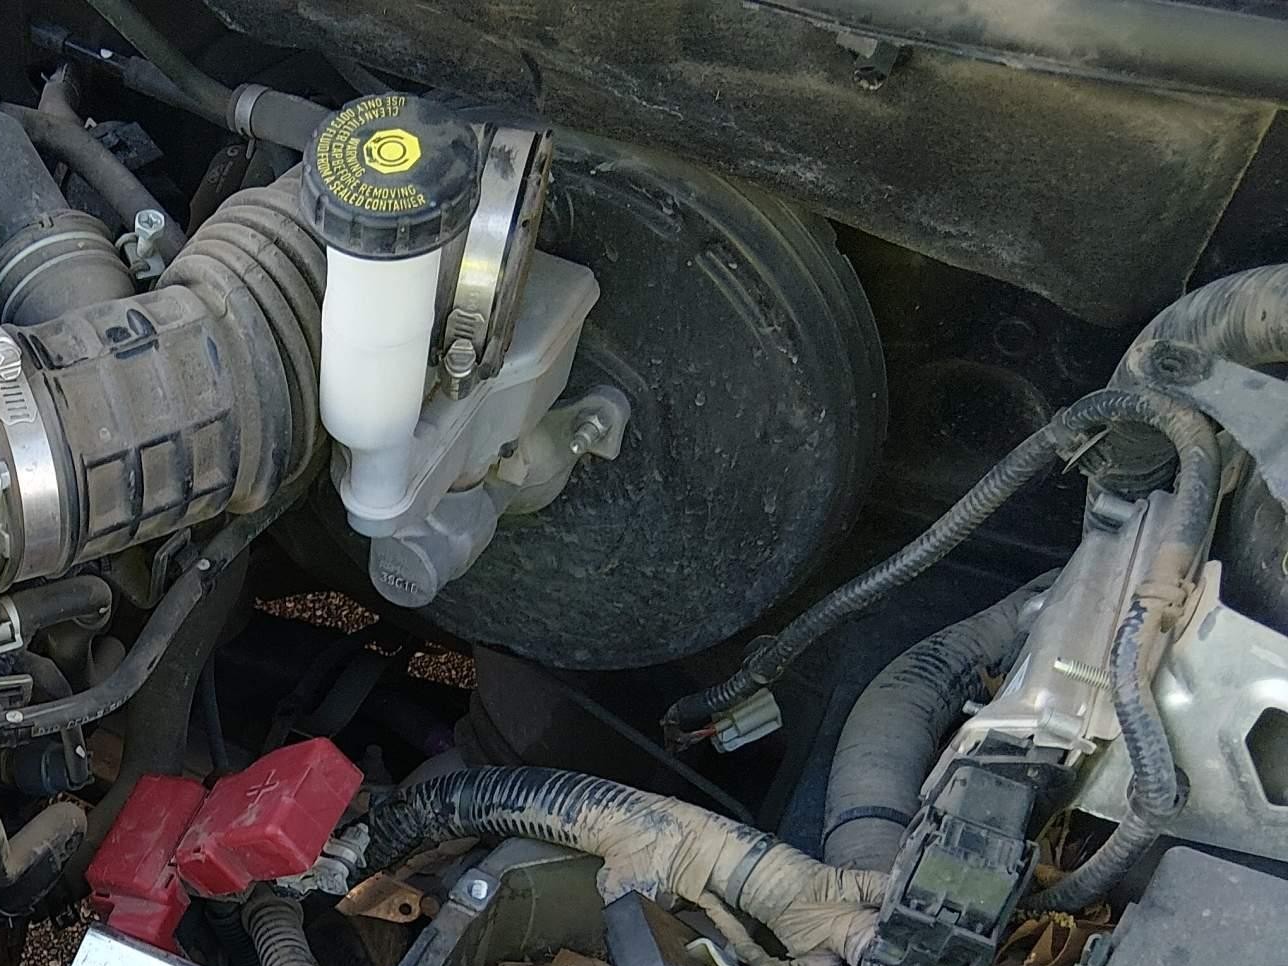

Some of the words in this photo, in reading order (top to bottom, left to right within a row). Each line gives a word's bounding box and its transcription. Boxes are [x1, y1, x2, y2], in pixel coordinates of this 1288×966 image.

[356, 98, 382, 112] ONLY
[386, 96, 406, 106] USE
[365, 106, 398, 119] CLEAN
[335, 114, 366, 142] FILLER
[318, 128, 336, 152] FLUID
[332, 142, 343, 160] CAP
[346, 137, 366, 178] WARNING
[316, 153, 332, 178] FROM
[330, 160, 360, 188] BEFORE
[329, 180, 364, 206] SEALED
[360, 183, 416, 199] REMOVING
[364, 194, 426, 212] CONTAINER
